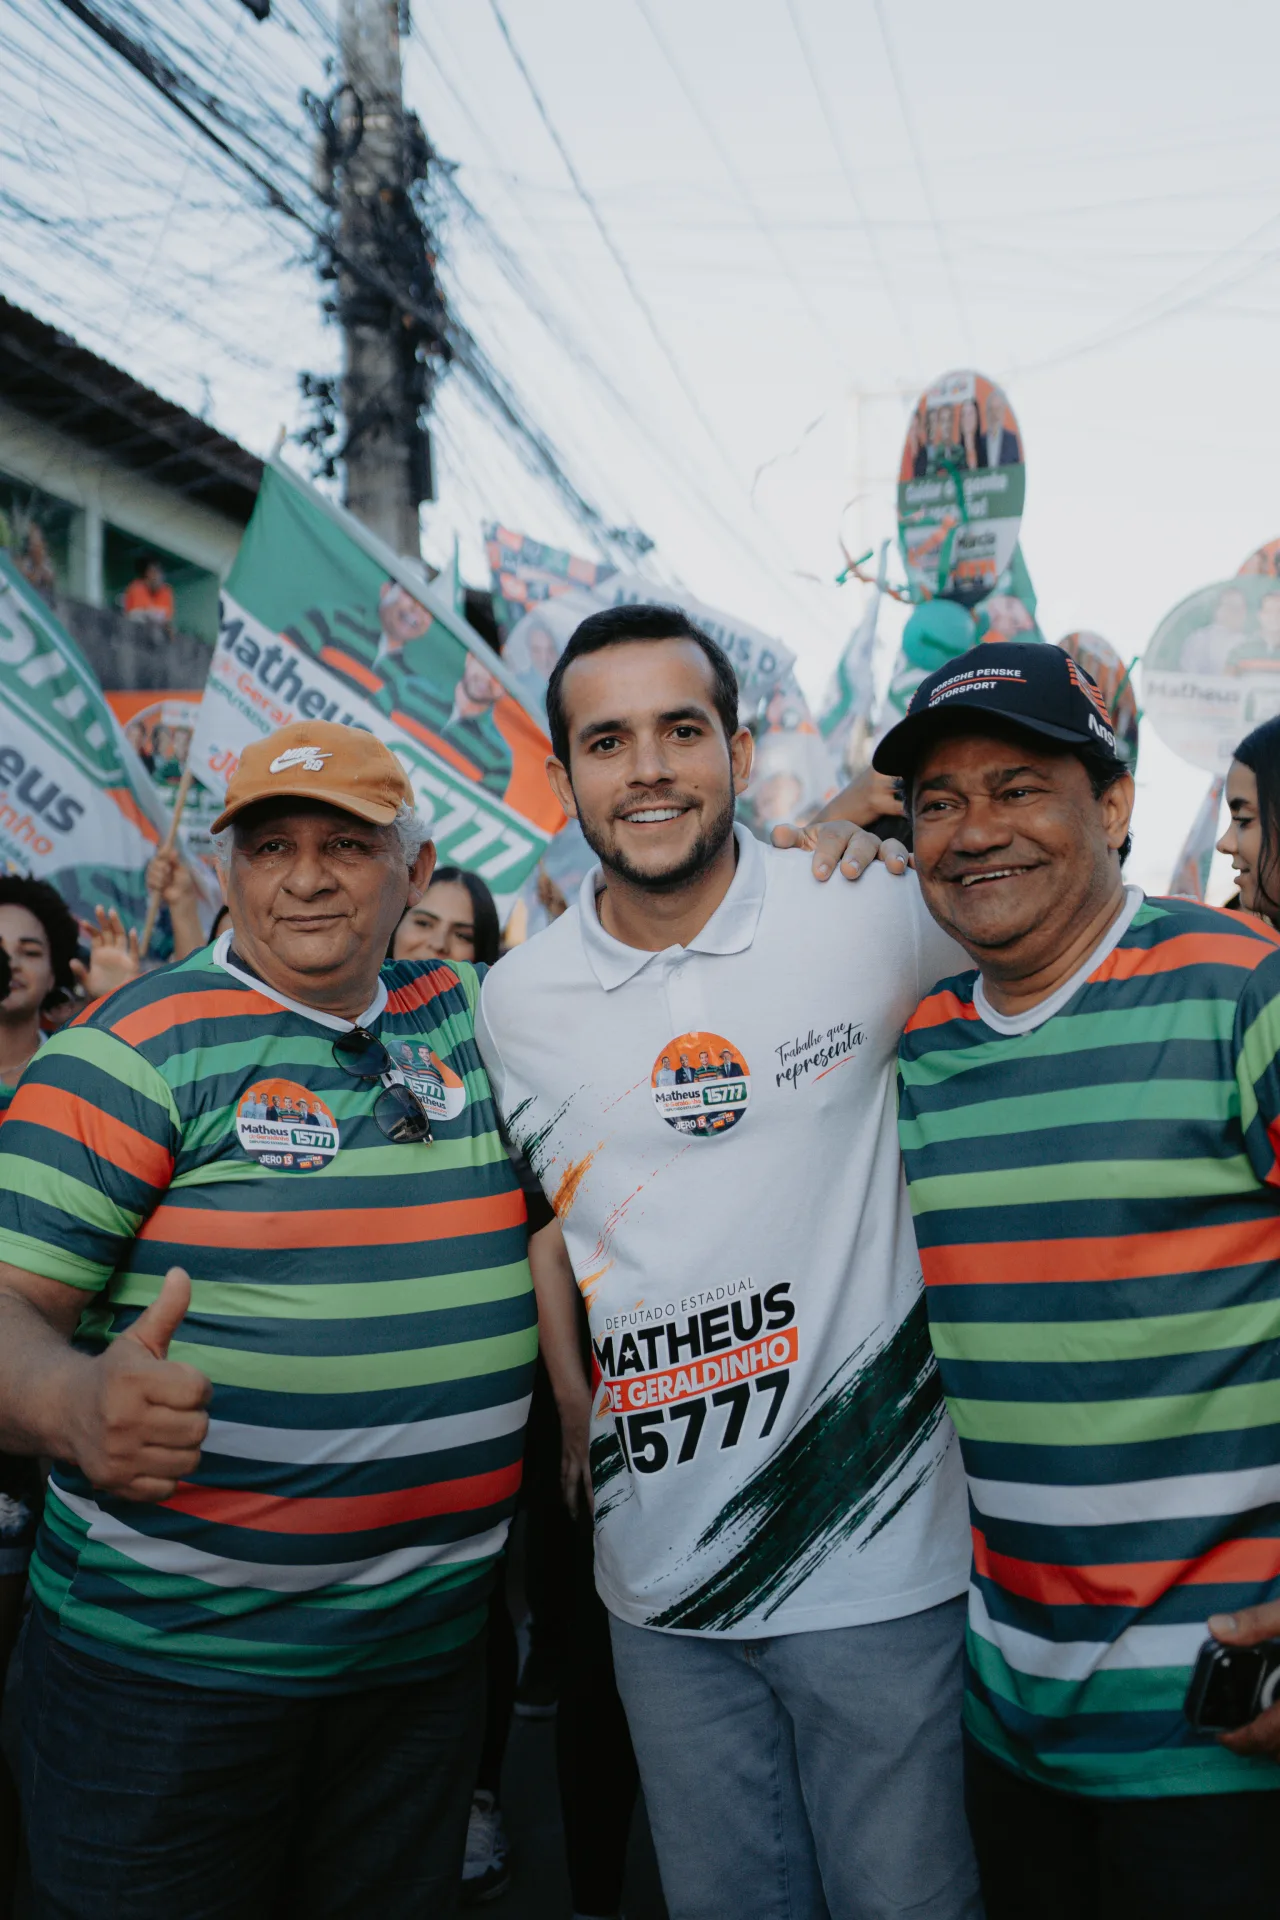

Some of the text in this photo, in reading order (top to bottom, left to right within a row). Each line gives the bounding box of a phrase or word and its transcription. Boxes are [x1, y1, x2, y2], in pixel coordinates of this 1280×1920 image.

[929, 681, 997, 708] MOTORSPORT
[931, 668, 1022, 695] PORSCHE PENSKE
[775, 1023, 846, 1067] Trabalho que
[655, 1089, 701, 1103] Matheus
[705, 1084, 743, 1104] 15777
[241, 1123, 289, 1137] Matheus
[293, 1130, 332, 1148] 15777
[283, 1154, 293, 1166] 13
[605, 1277, 756, 1331] DEPUTADO ESTADUAL
[592, 1282, 796, 1378] MATHEUS
[627, 1335, 791, 1408] GERALDINHO
